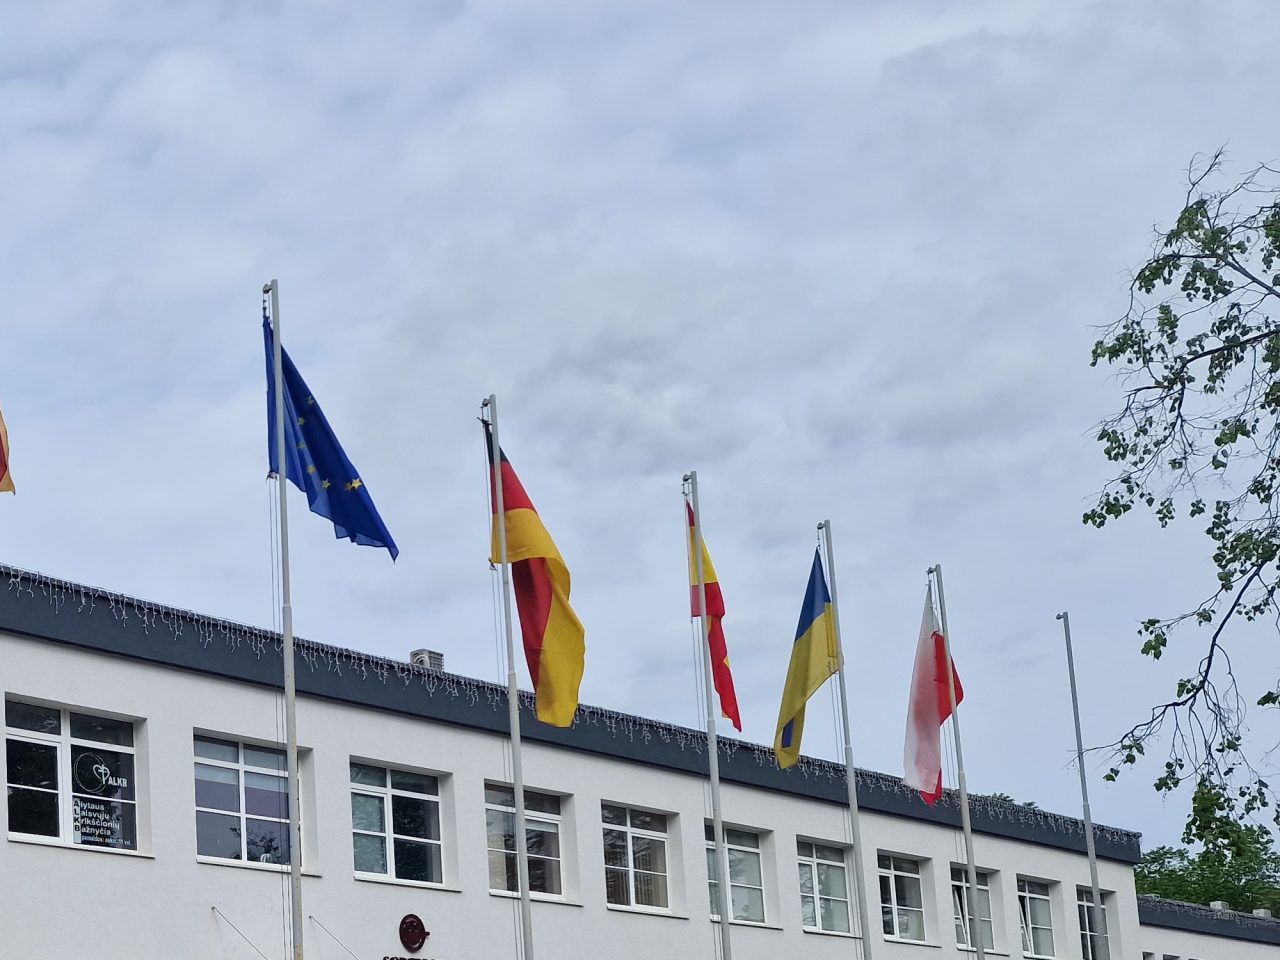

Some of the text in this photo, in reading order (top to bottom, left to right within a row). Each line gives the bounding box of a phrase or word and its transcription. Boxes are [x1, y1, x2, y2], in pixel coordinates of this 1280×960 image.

[108, 776, 128, 787] ALKB
[74, 800, 105, 811] Alytaus
[75, 825, 111, 836] Bažnyčia
